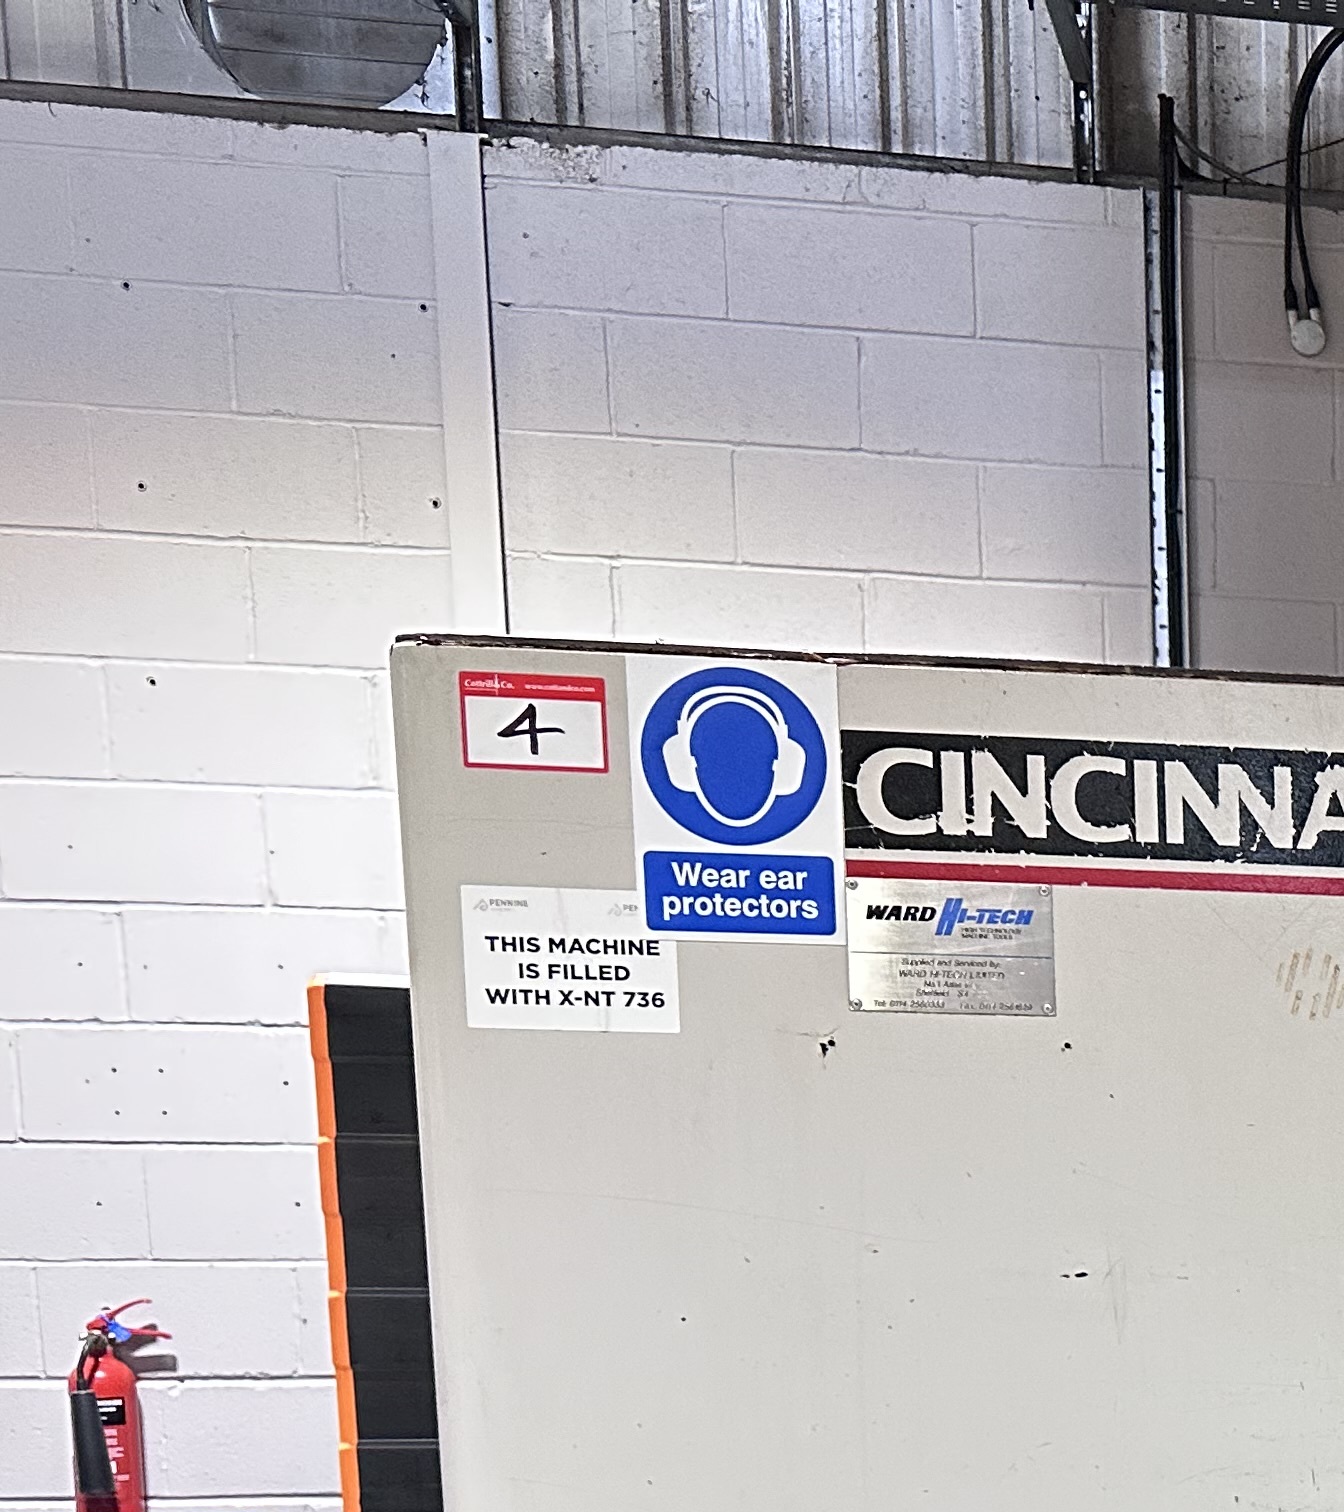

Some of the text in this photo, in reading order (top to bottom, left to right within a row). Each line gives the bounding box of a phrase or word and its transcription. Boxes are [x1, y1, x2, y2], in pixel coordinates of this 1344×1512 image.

[496, 702, 566, 755] 4
[671, 861, 808, 890] Wear ear
[662, 893, 819, 921] protectors
[866, 904, 937, 922] WARD
[484, 935, 661, 957] THIS MACHINE
[518, 963, 631, 981] IS FILLED
[485, 987, 666, 1009] WITH X-NT 736
